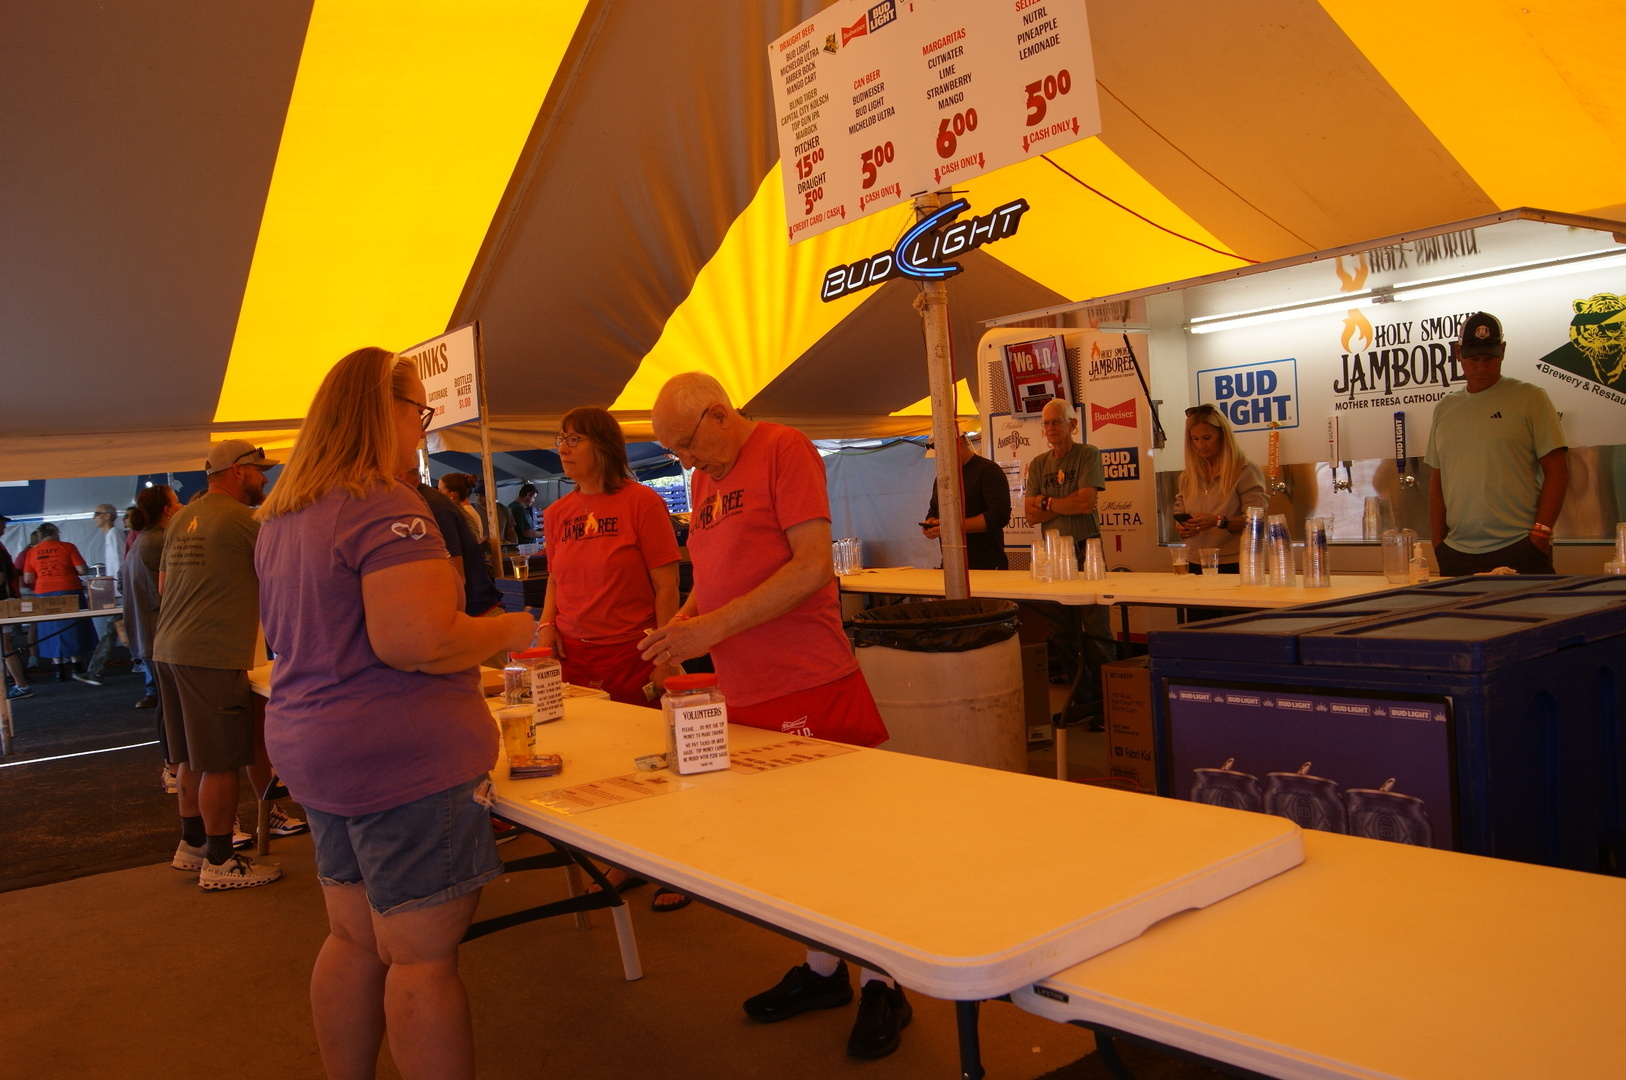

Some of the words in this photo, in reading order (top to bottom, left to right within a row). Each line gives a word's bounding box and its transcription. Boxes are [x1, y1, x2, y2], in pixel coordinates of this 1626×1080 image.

[872, 1, 891, 19] BUD
[1015, 0, 1042, 12] SELT
[1022, 6, 1048, 26] NUTRL
[870, 8, 896, 31] LIGHT
[779, 32, 801, 52] DRAUGHT
[801, 23, 815, 38] BEER
[922, 28, 966, 56] MARGARITAS
[1017, 17, 1058, 45] PINEAPPLE
[785, 50, 797, 62] BUD
[796, 40, 811, 56] LIGHT
[927, 45, 964, 70] CUTWATER
[1019, 33, 1061, 61] LEMONADE
[780, 56, 804, 77] MICHELOB
[803, 47, 820, 62] ULTRA
[785, 70, 802, 85] AMBER
[802, 60, 817, 76] BOCK
[939, 64, 956, 80] LIME
[786, 79, 804, 96] MANGO
[804, 72, 817, 86] CART
[853, 76, 866, 90] CAN
[865, 69, 881, 84] BEER
[926, 72, 972, 100] STRAWBERRY
[788, 96, 803, 111] BLIND
[803, 88, 818, 103] TIGER
[852, 82, 885, 105] BUDWEISER
[938, 91, 965, 110] MANGO
[780, 109, 800, 126] CAPITAL
[799, 103, 810, 116] CITY
[855, 106, 867, 118] BUD
[867, 96, 885, 112] LIGHT
[791, 120, 801, 132] TOP
[800, 115, 811, 127] GUN
[811, 110, 820, 121] IPA
[848, 114, 877, 136] MICHELOB
[877, 106, 896, 122] ULTRA
[1029, 127, 1050, 143] CASH
[1051, 119, 1071, 136] ONLY
[794, 135, 820, 157] PITCHER
[940, 161, 960, 176] CASH
[960, 154, 978, 169] ONLY
[797, 172, 826, 194] DRAUGHT
[864, 191, 881, 204] CASH
[880, 184, 896, 198] ONLY
[792, 218, 809, 233] CREDIT
[809, 212, 823, 227] CARD
[826, 206, 841, 219] CASH
[822, 254, 892, 299] BUD
[911, 203, 1022, 266] LIGHT
[1375, 321, 1413, 348] HOLY
[1420, 311, 1483, 342] SMOK
[1013, 351, 1033, 373] We
[1034, 347, 1056, 370] I.D.
[1088, 355, 1135, 379] JAMBOREE
[1333, 340, 1468, 400] JAMBORE
[454, 373, 472, 387] BOTTLED
[457, 384, 471, 396] WATER
[1215, 370, 1278, 400] BUD
[1541, 364, 1583, 388] Brewery
[1582, 381, 1591, 391] &
[1591, 384, 1626, 406] Restau
[428, 388, 448, 402] GATORADE
[459, 397, 471, 409] $1.00
[1335, 397, 1369, 411] MOTHER
[1370, 394, 1401, 407] TERESA
[1094, 411, 1134, 421] Budweiser
[1219, 395, 1291, 425] IGHT
[1395, 419, 1403, 442] LIGHT
[1101, 451, 1131, 465] BUD
[1396, 443, 1404, 459] BUD
[1104, 464, 1137, 478] IGHT
[37, 547, 59, 555] STAFF
[537, 668, 561, 680] VOLUNTEERS
[1193, 693, 1209, 701] LIGHT
[682, 707, 722, 720] VOLUNTEERS
[1332, 704, 1347, 712] BUD
[1347, 706, 1368, 714] LIGHT
[1391, 709, 1407, 717] BUD
[1407, 711, 1429, 719] LIGHT
[797, 727, 814, 737] ID.
